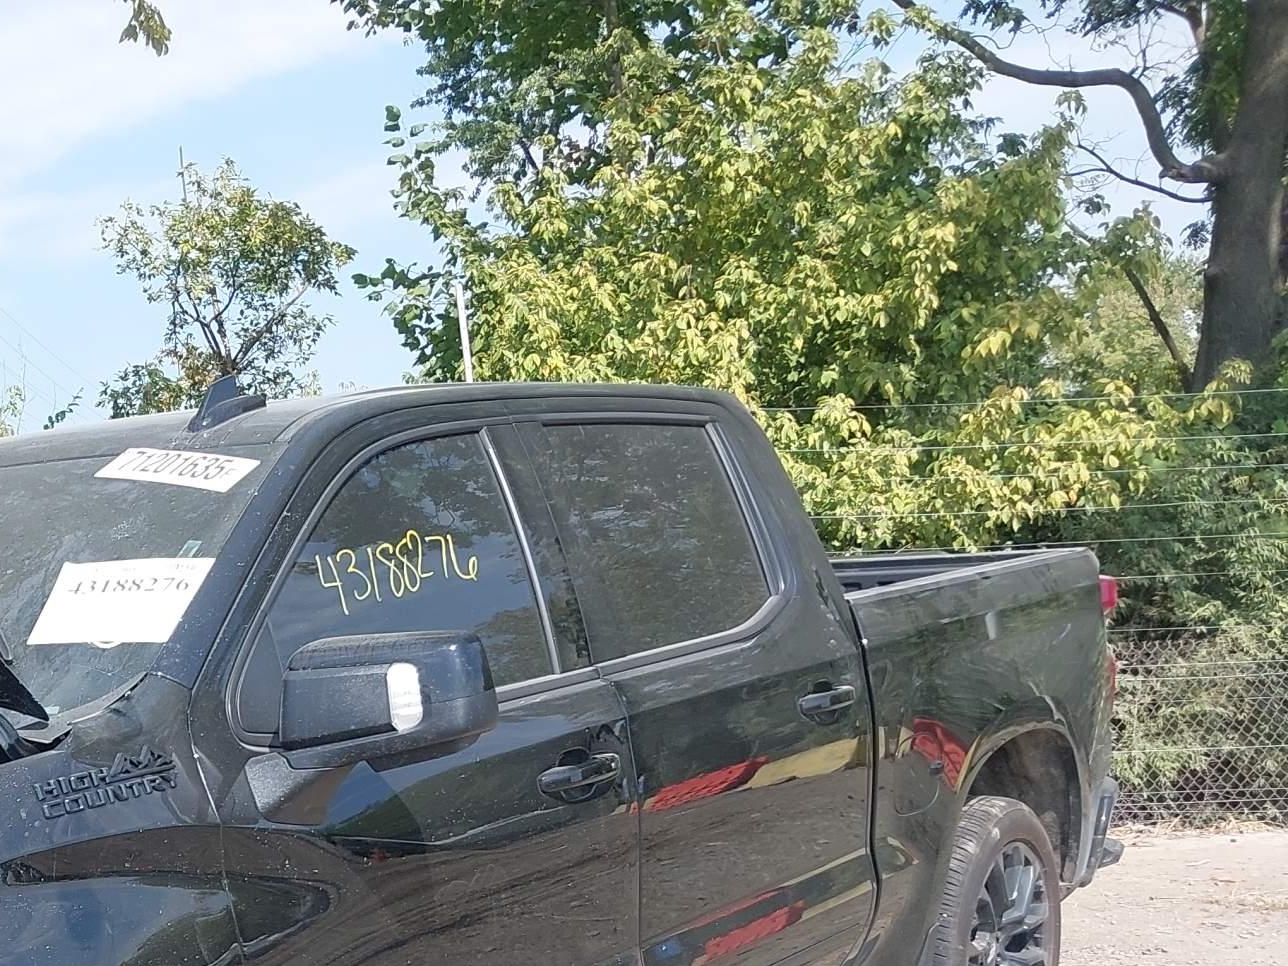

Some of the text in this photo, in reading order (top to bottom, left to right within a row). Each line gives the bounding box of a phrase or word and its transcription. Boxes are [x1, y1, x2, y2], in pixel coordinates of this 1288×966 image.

[117, 450, 234, 481] 71201635
[67, 576, 190, 595] 43188276
[315, 529, 478, 615] 43188276
[33, 766, 112, 801] HIGH
[42, 771, 178, 820] COUNTRY
